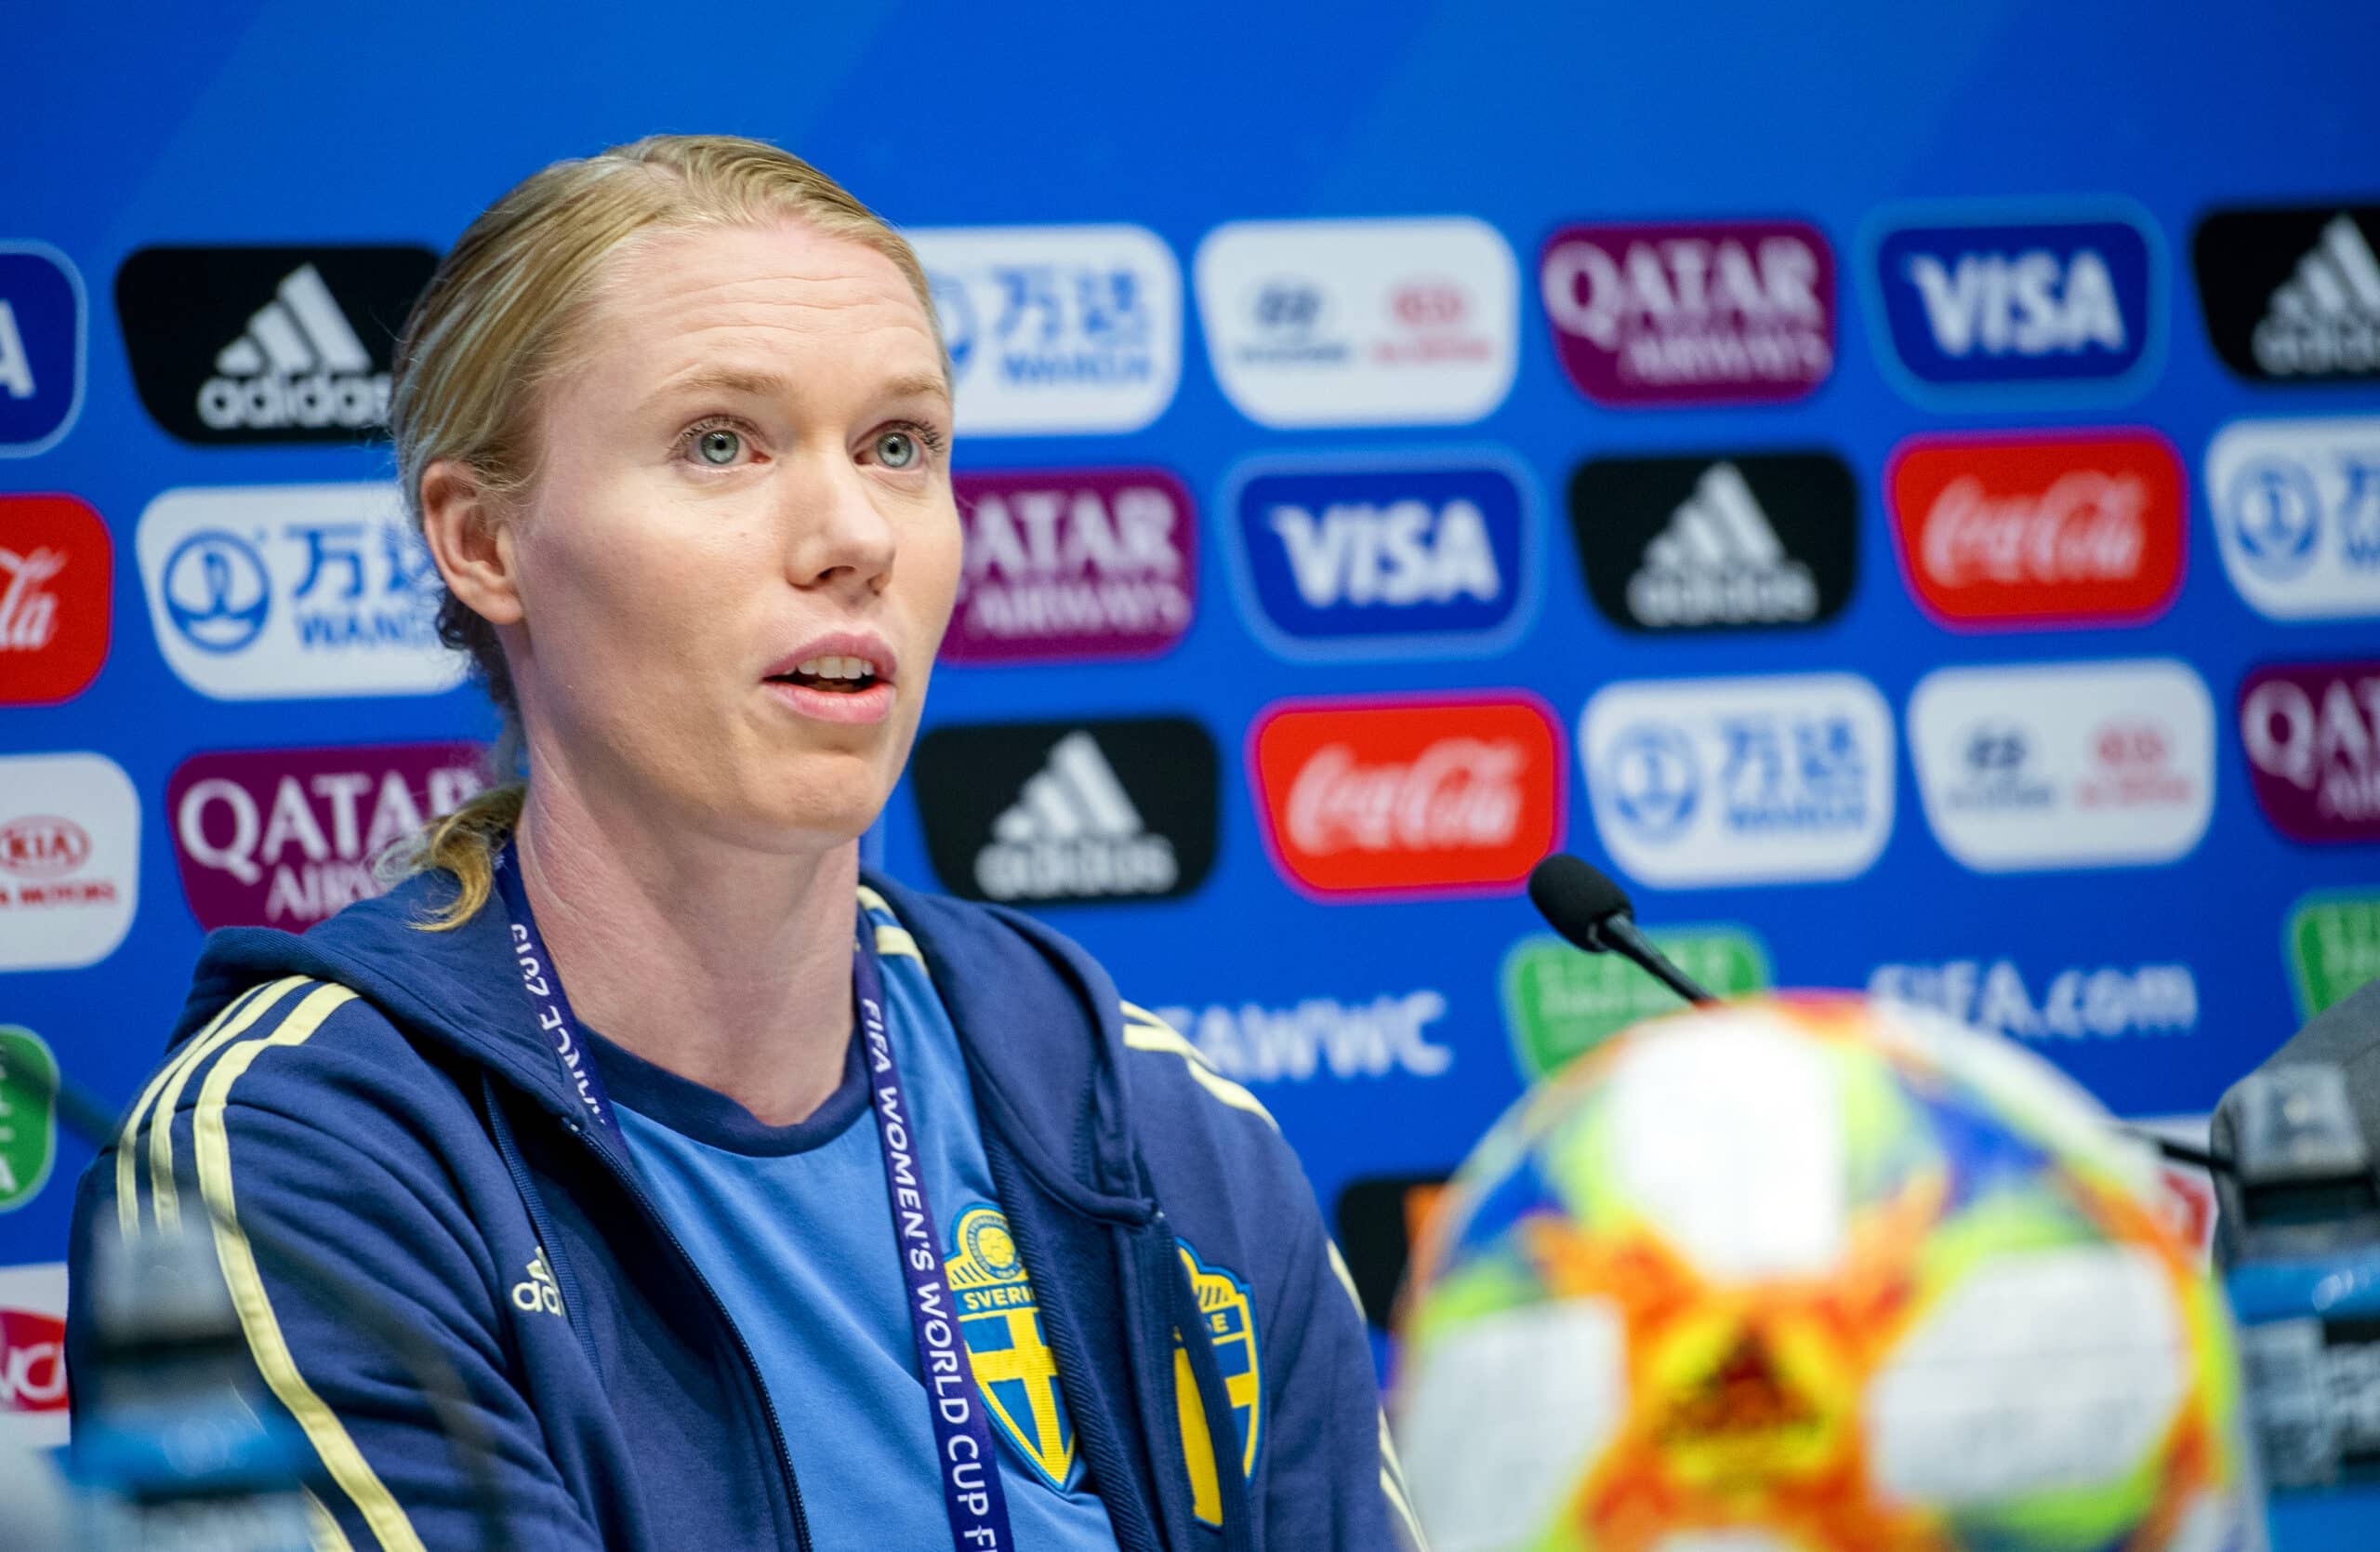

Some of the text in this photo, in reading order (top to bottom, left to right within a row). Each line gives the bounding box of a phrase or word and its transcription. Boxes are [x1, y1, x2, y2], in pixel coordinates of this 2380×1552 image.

[1541, 235, 1824, 352] QATAR
[1908, 246, 2126, 358] VISA
[1268, 500, 1501, 610] VISA
[1627, 558, 1820, 629] adidas
[1285, 737, 1525, 857] Coca-Cola
[974, 833, 1180, 900] adidas
[862, 998, 892, 1073] FIFA
[879, 1086, 935, 1272] WOMEN'S
[917, 1281, 970, 1426] WORLD
[946, 1435, 989, 1517] CUP
